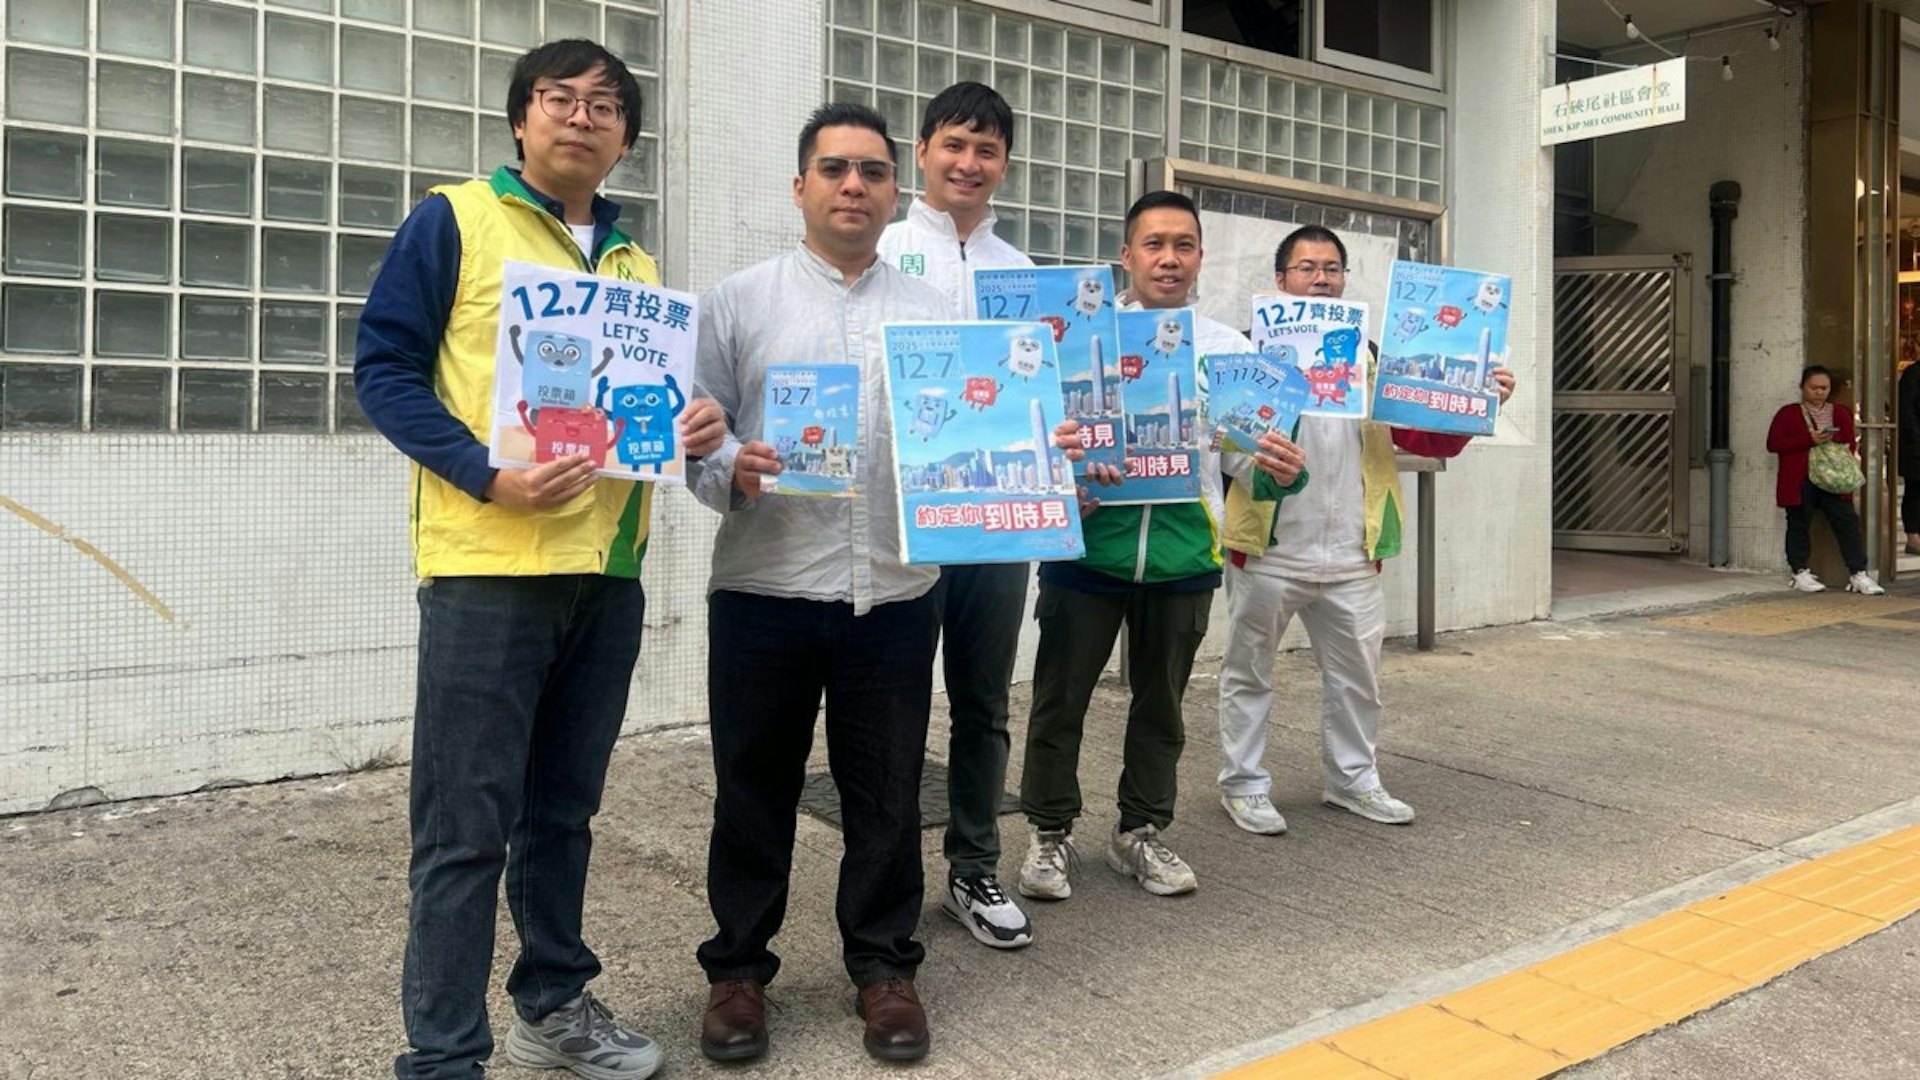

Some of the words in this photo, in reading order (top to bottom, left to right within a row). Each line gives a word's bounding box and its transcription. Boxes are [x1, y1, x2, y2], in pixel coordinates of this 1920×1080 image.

[1566, 121, 1580, 131] KIP
[1583, 118, 1599, 128] MEI
[1600, 108, 1654, 125] COMMUNITY
[1657, 103, 1681, 113] HALL
[511, 281, 599, 321] 12.7
[604, 286, 692, 332] 齊投票
[1257, 301, 1307, 327] 12.7
[1310, 303, 1364, 327] 齊投票
[602, 322, 650, 343] LET'S
[1268, 326, 1293, 338] LET'S
[1294, 324, 1319, 333] VOTE
[620, 343, 669, 368] VOTE
[916, 500, 1068, 531] 約定你到時見
